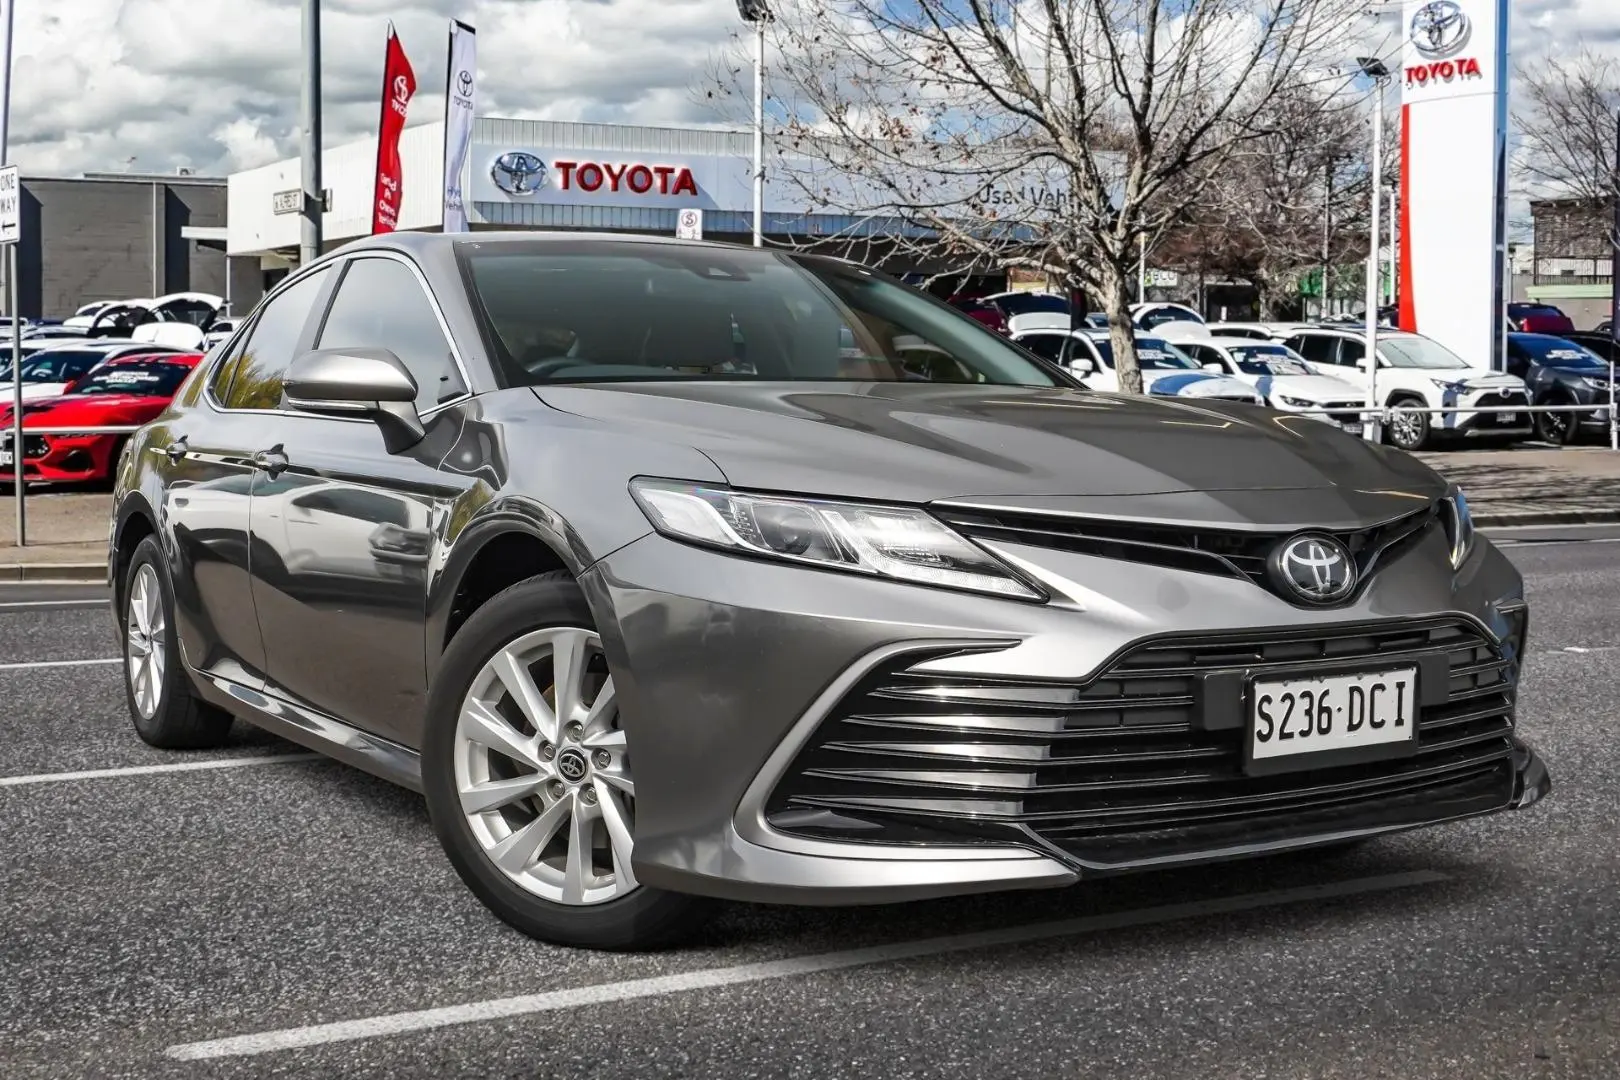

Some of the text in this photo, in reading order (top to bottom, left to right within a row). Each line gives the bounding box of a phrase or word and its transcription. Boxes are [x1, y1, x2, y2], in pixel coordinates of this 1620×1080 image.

[1404, 58, 1481, 83] TOYOTA
[0, 173, 15, 191] ONE
[554, 161, 698, 196] TOYOTA
[0, 195, 16, 213] WAY
